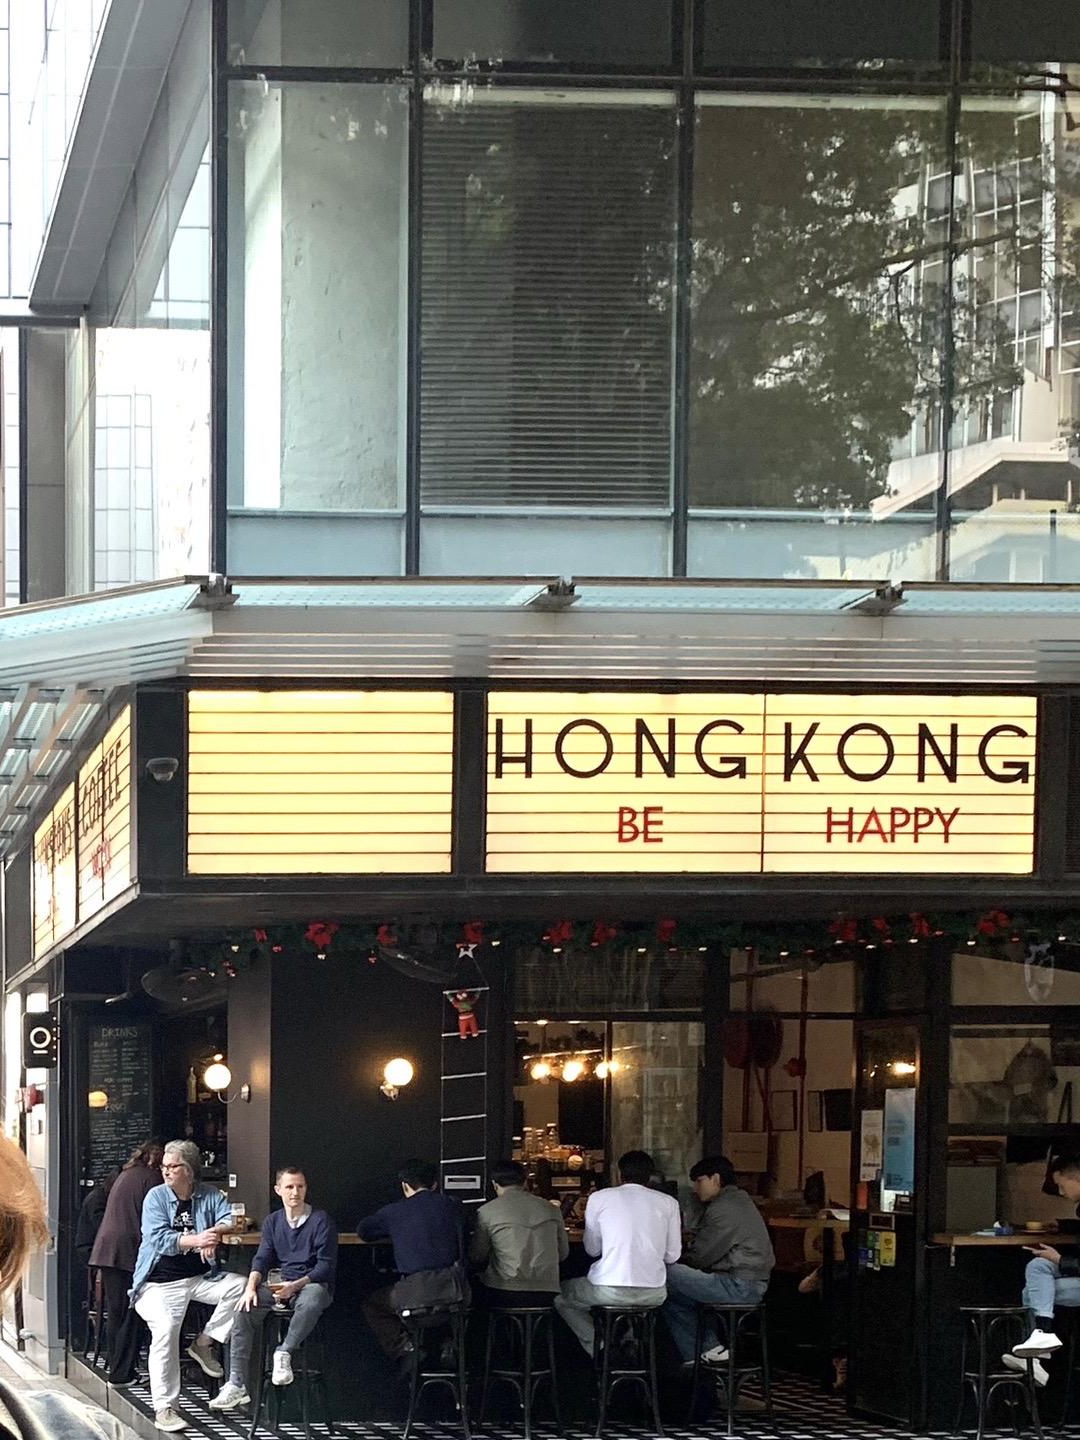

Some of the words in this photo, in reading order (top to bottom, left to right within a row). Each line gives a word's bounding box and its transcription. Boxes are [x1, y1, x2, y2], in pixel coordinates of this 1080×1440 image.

[495, 718, 747, 779] HONG
[783, 722, 1030, 784] KONG
[617, 806, 664, 844] BE
[826, 806, 961, 844] HAPPY
